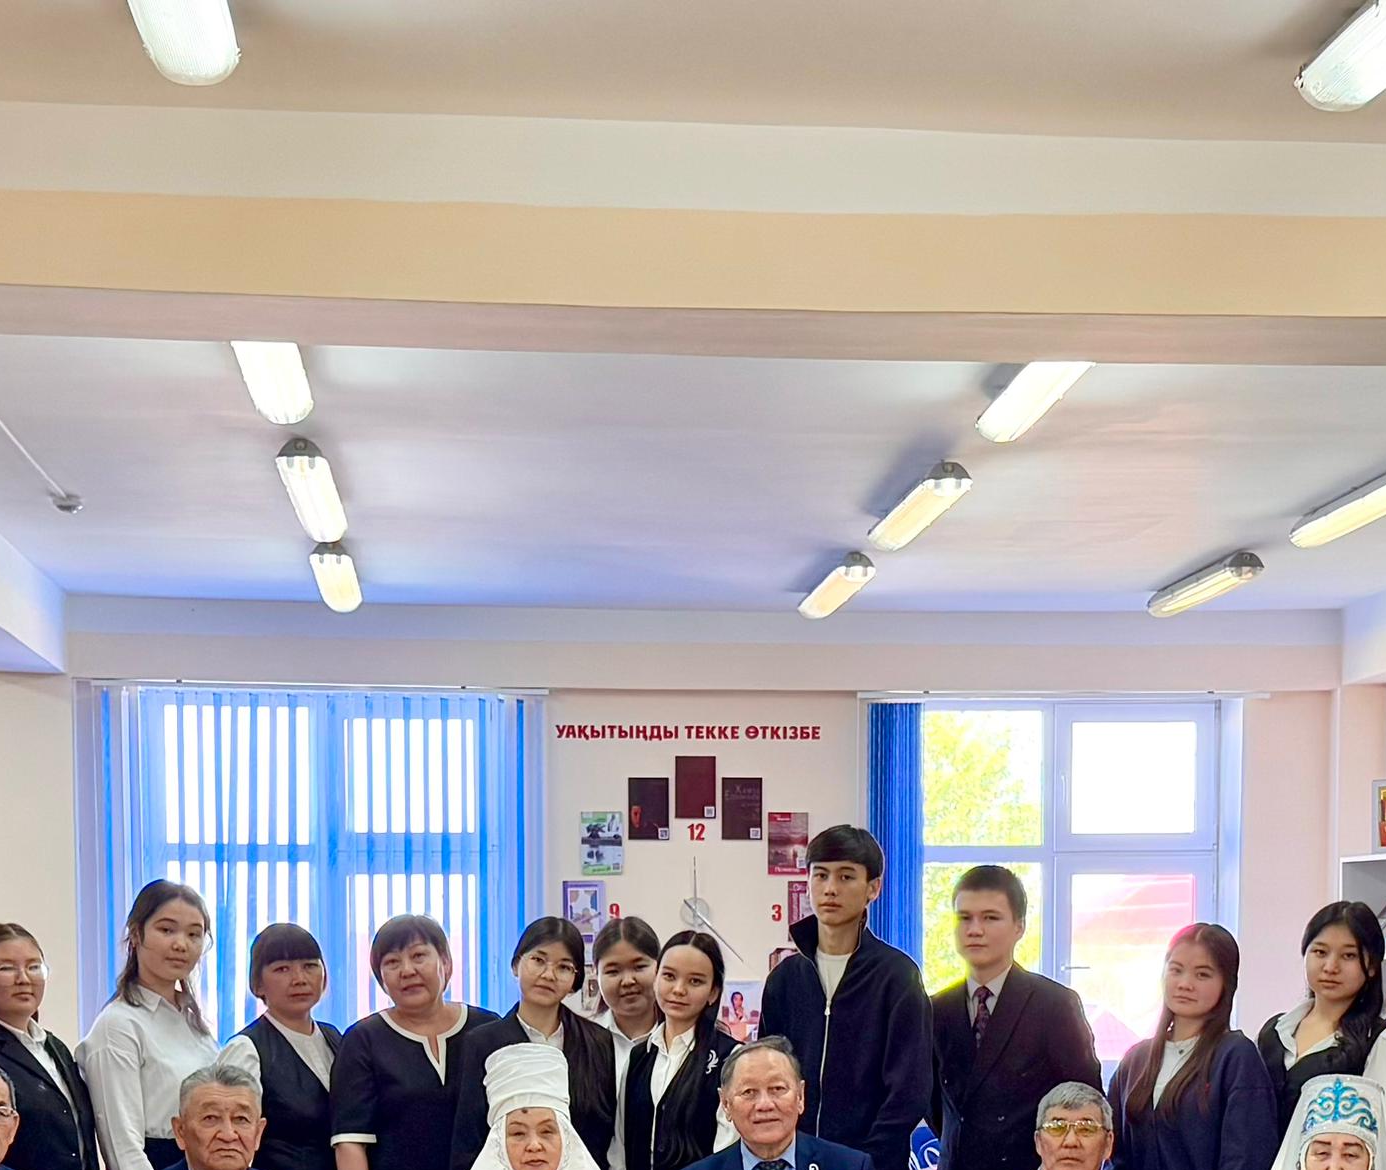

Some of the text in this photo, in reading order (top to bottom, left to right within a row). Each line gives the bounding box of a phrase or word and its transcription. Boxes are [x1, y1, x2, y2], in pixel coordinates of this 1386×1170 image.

[556, 724, 821, 741] УАҚЫТЫҢДЫ ТЕККЕ ӨТКІЗБЕ
[687, 823, 706, 841] 12
[609, 903, 620, 919] 9
[771, 904, 782, 921] 3
